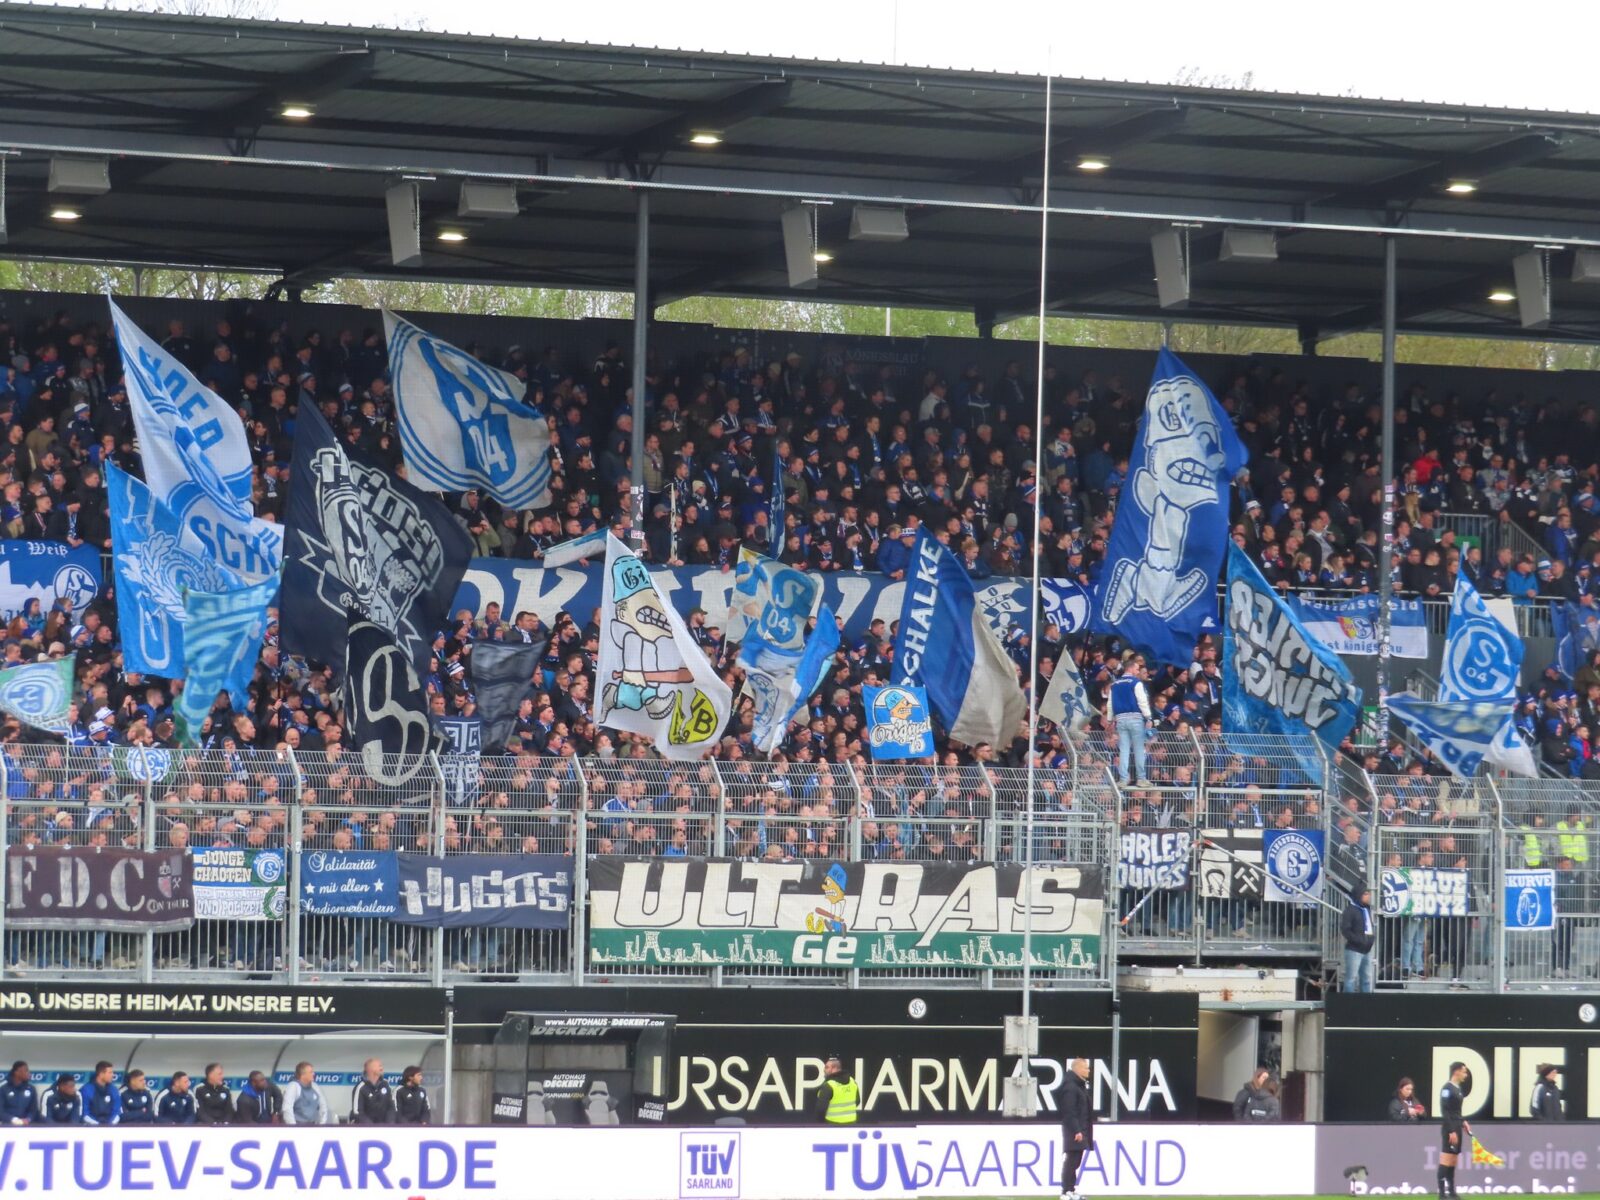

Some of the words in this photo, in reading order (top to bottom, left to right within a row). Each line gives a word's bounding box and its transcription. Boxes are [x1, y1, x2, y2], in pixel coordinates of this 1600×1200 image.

[26, 541, 68, 558] Weiß
[870, 714, 932, 747] Original
[202, 850, 245, 866] JUNGE
[1120, 832, 1190, 865] ARLER
[308, 851, 377, 873] Solidarität
[193, 866, 252, 882] CHAOTEN
[1410, 870, 1467, 893] BLUE
[1505, 874, 1552, 888] KURVE
[319, 882, 338, 894] mit
[340, 878, 371, 893] allen
[400, 867, 568, 916] HUGOS
[197, 899, 220, 916] UND
[1412, 893, 1467, 915] BOYZ
[39, 993, 121, 1010] UNSERE
[127, 994, 207, 1011] HEIMAT.
[212, 995, 292, 1012] UNSERE
[297, 996, 336, 1013] ELV.
[315, 1074, 342, 1083] HYLO
[543, 1079, 585, 1088] DECKERT
[1431, 1045, 1566, 1118] DIE
[686, 1140, 737, 1176] TÜV
[1529, 1143, 1588, 1171] eine
[686, 1178, 734, 1189] SAARLAND
